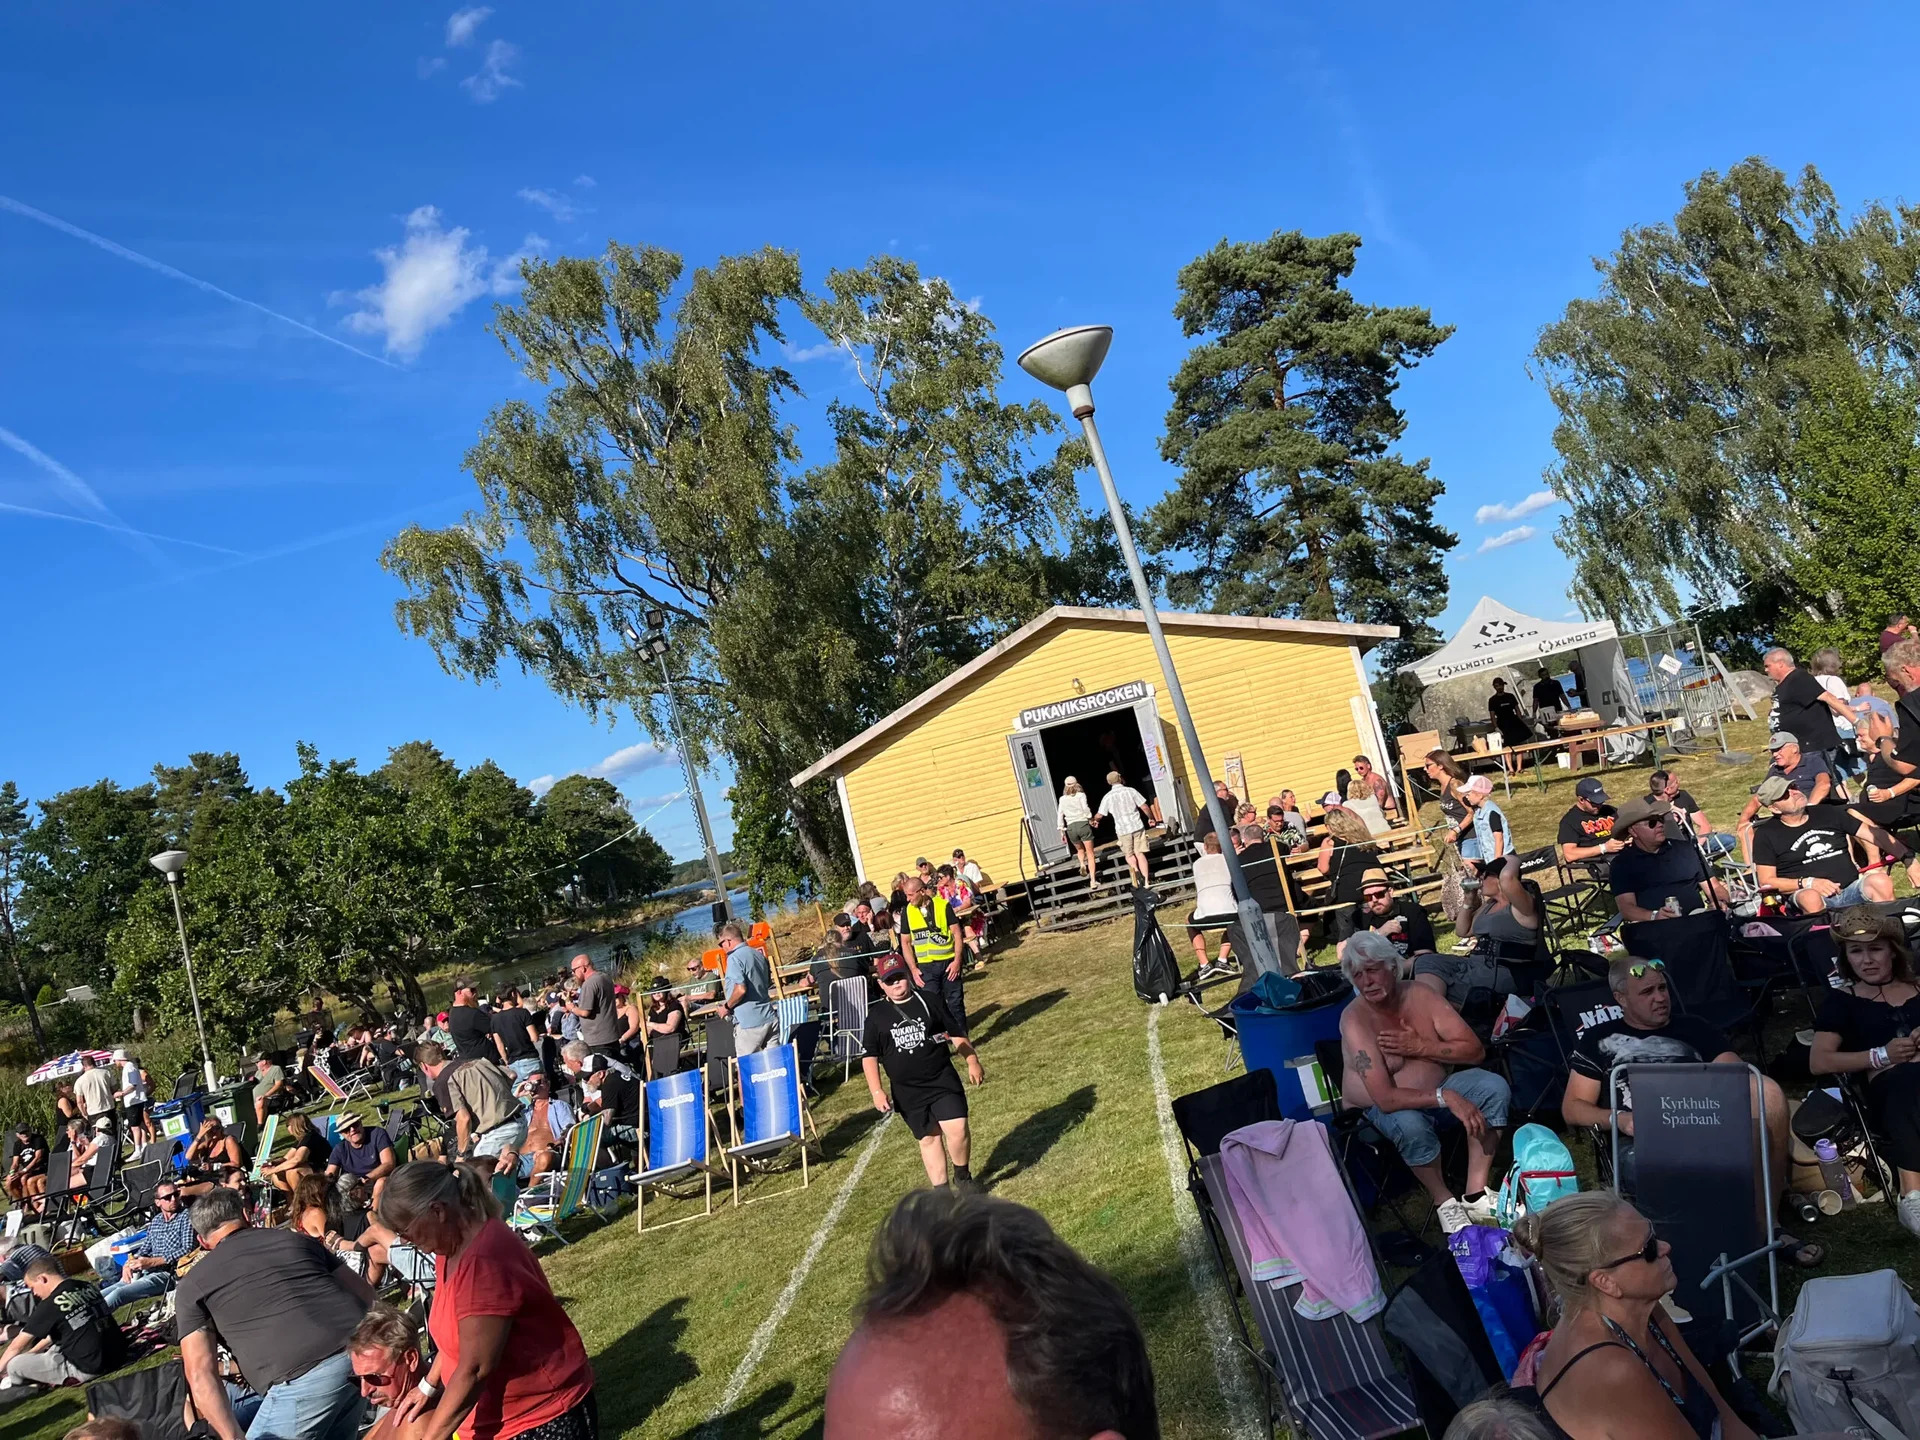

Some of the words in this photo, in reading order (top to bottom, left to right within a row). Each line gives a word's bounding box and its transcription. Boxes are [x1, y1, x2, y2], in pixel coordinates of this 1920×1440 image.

[1473, 630, 1539, 649] XLMOTO
[1555, 631, 1597, 648] XLMOTO
[1453, 657, 1495, 673] XLMOTO
[1023, 683, 1144, 725] PUKAVIKSROCKEN
[894, 1031, 926, 1048] ROCKEN
[1660, 1096, 1721, 1113] Kyrkhults
[1662, 1112, 1721, 1128] Sparbank
